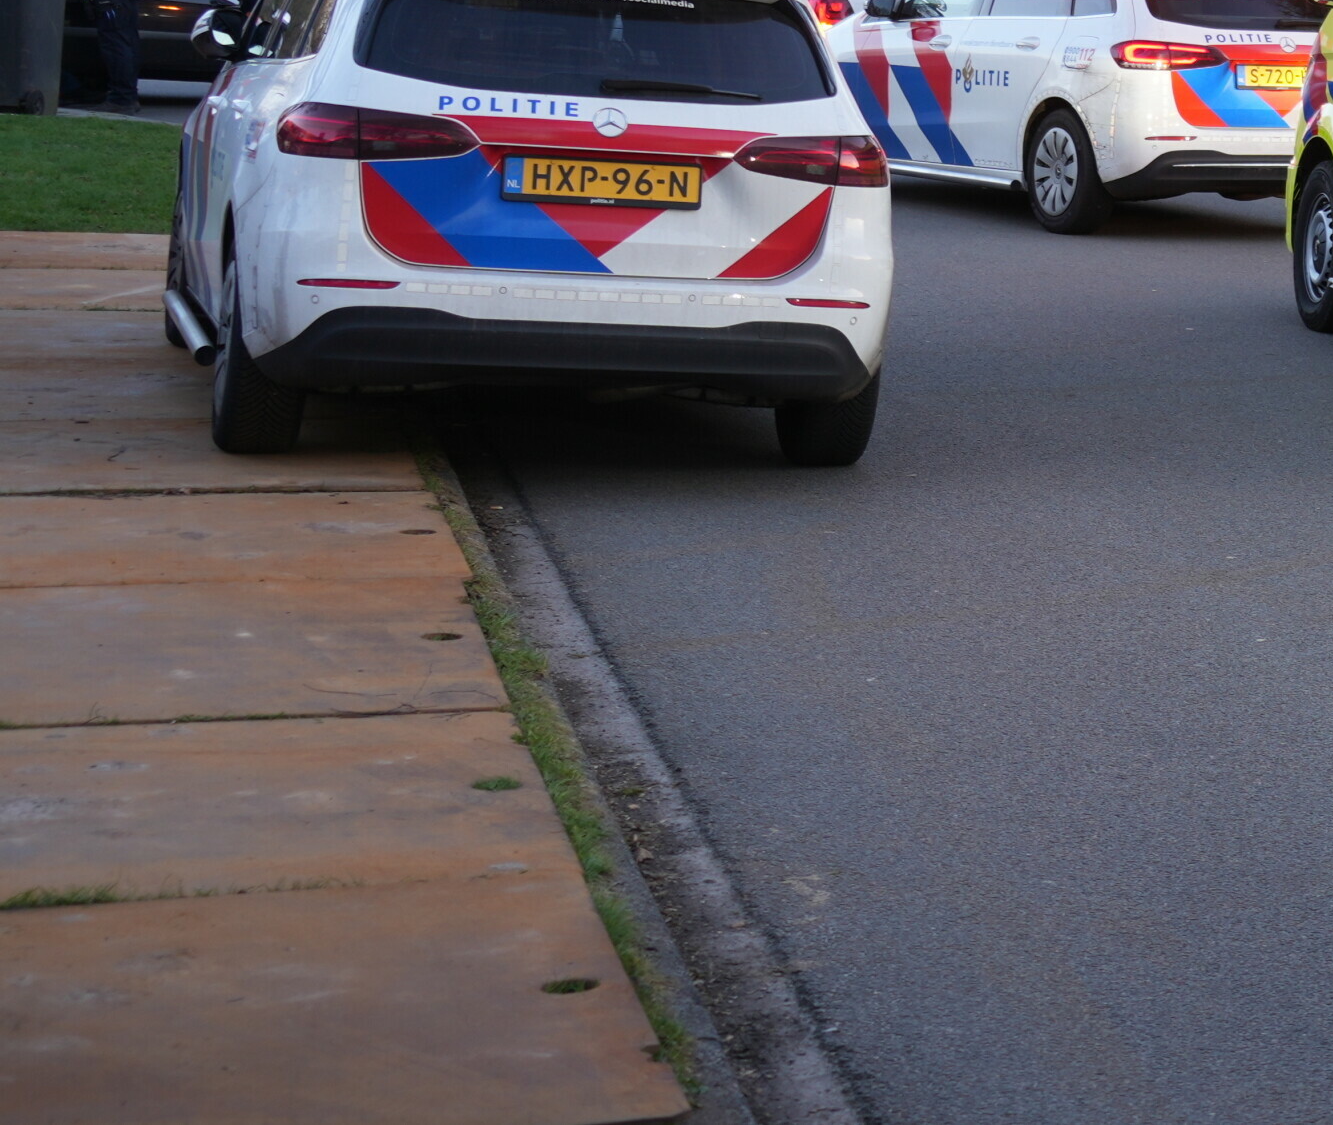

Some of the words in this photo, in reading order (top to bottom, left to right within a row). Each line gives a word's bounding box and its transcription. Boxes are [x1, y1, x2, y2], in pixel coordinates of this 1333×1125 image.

[1205, 34, 1272, 43] POLITIE
[1079, 48, 1096, 62] 112
[955, 66, 1009, 93] POLITIE
[438, 95, 579, 117] POLITIE
[507, 179, 521, 189] NL
[531, 163, 689, 197] HXP-96-N
